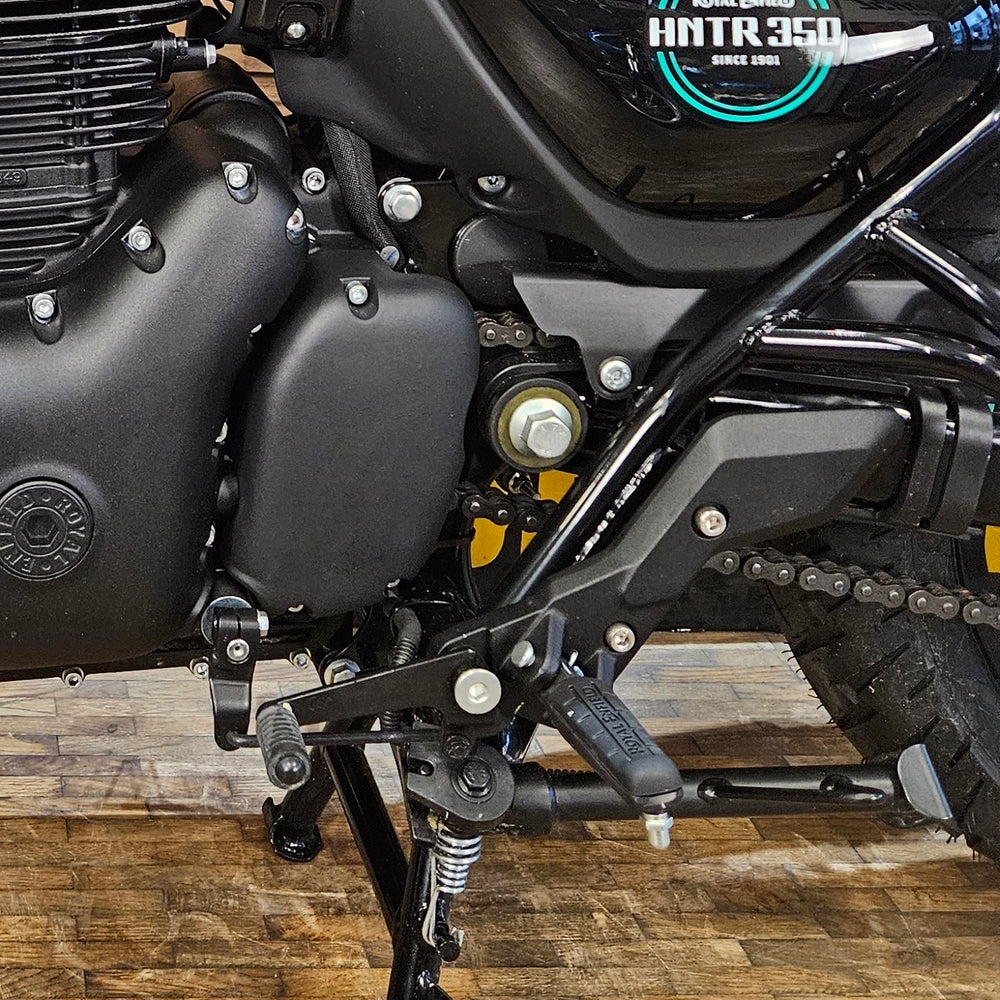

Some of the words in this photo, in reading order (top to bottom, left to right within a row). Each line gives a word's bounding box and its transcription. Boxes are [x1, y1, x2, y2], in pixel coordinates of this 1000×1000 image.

[648, 16, 763, 48] HNTR
[766, 16, 843, 48] 350
[711, 55, 749, 66] SINCE
[750, 55, 781, 66] 1901
[54, 498, 86, 566] ROYAL
[582, 686, 620, 723] ENFIELD
[612, 723, 645, 755] ROYAL
